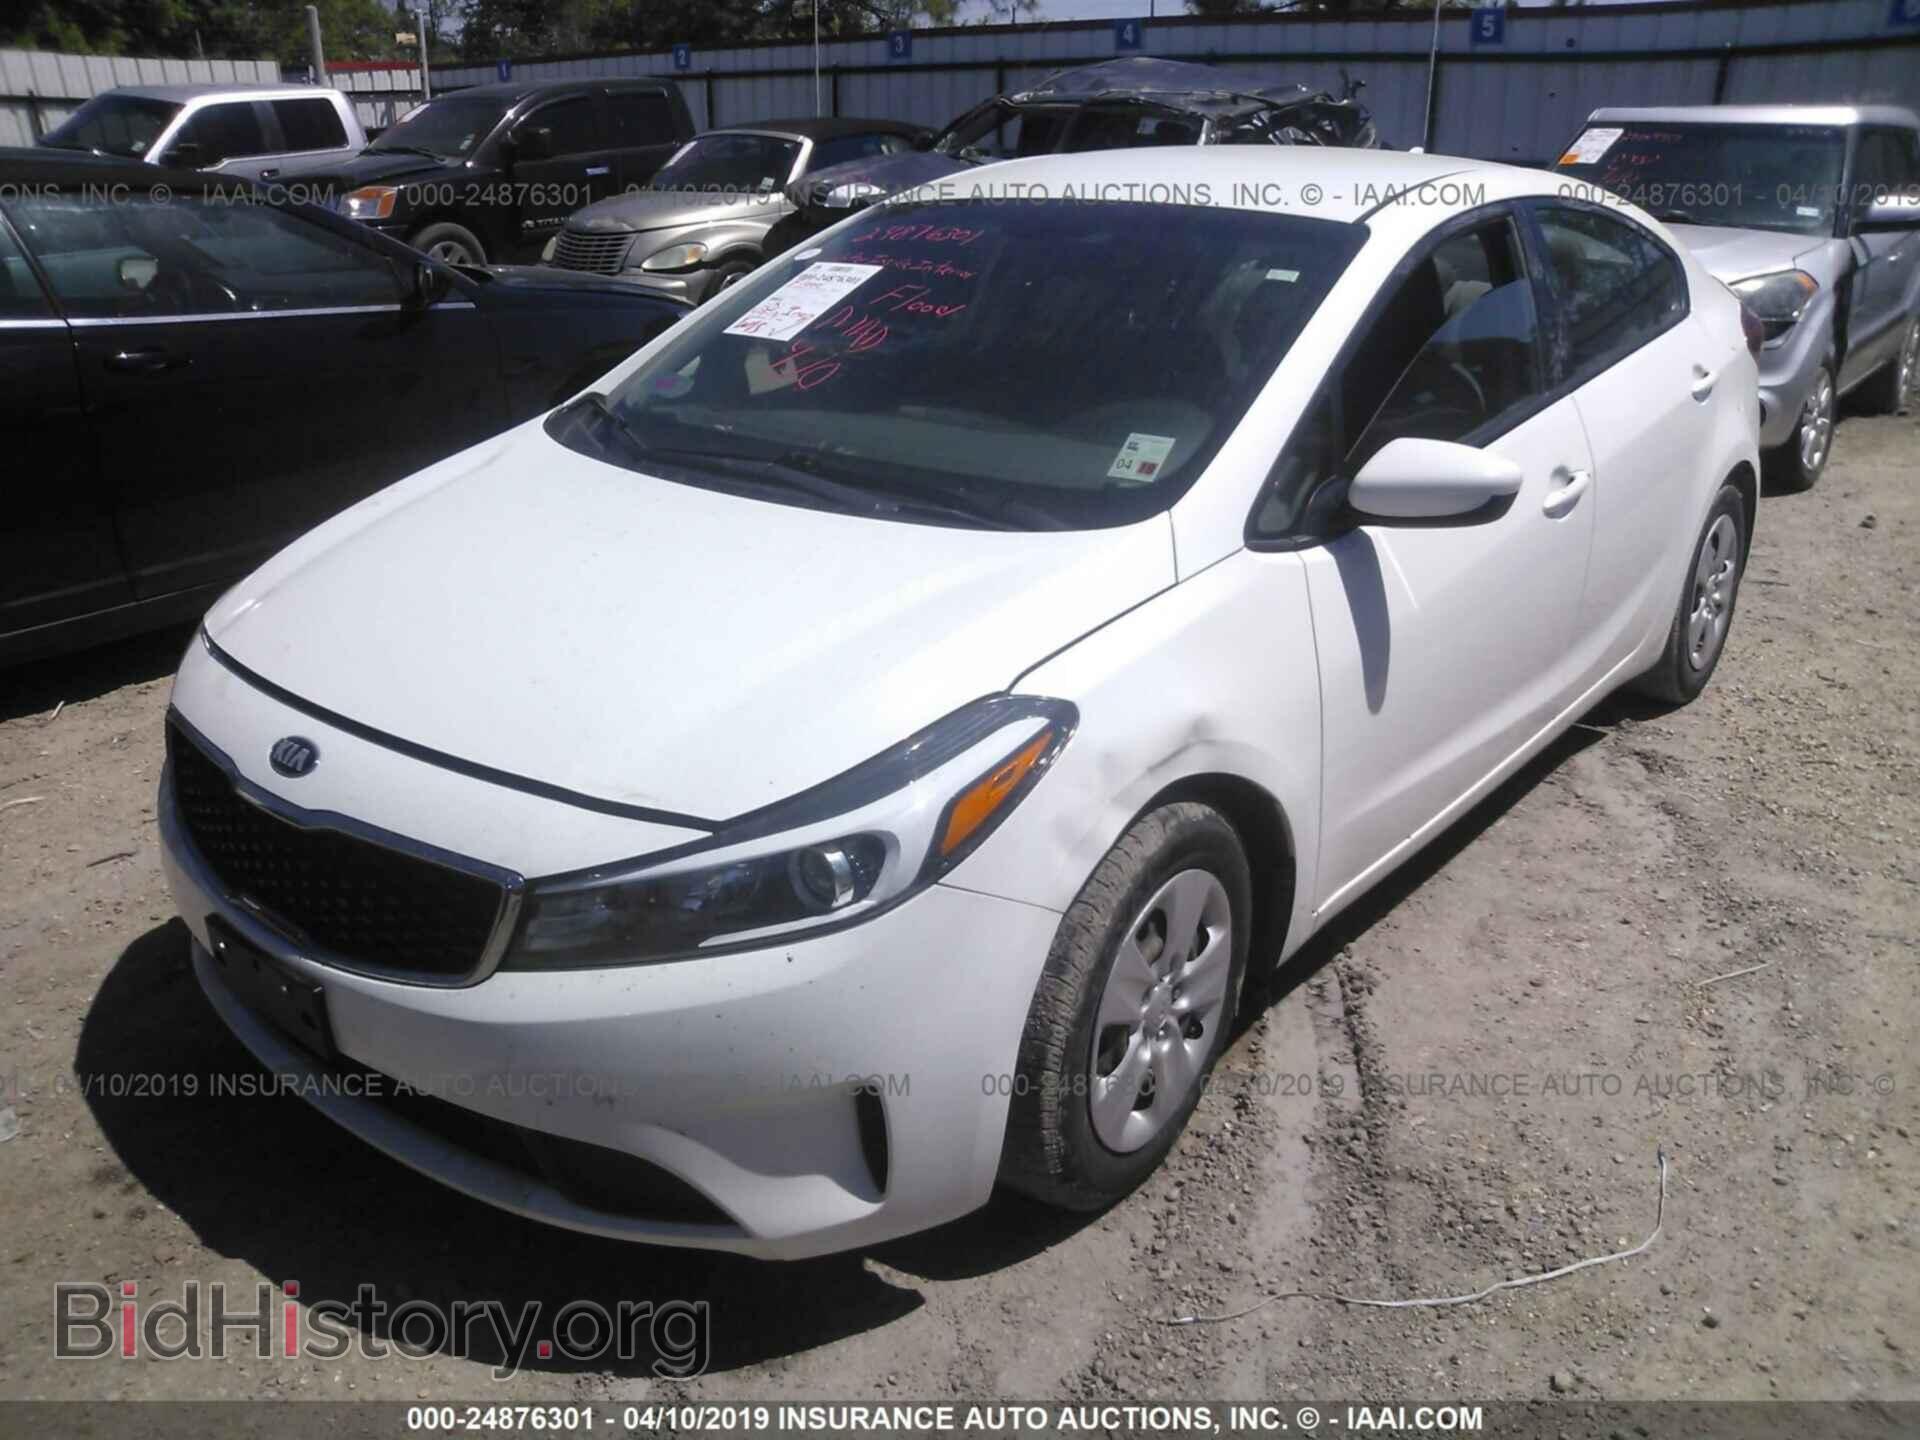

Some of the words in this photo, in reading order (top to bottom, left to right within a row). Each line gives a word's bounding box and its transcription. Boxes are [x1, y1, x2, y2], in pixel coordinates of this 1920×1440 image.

[1123, 24, 1133, 45] 4
[1481, 14, 1495, 37] 5
[896, 35, 904, 53] 3
[678, 50, 687, 66] 2
[869, 283, 968, 318] Flood
[271, 740, 311, 772] KIA
